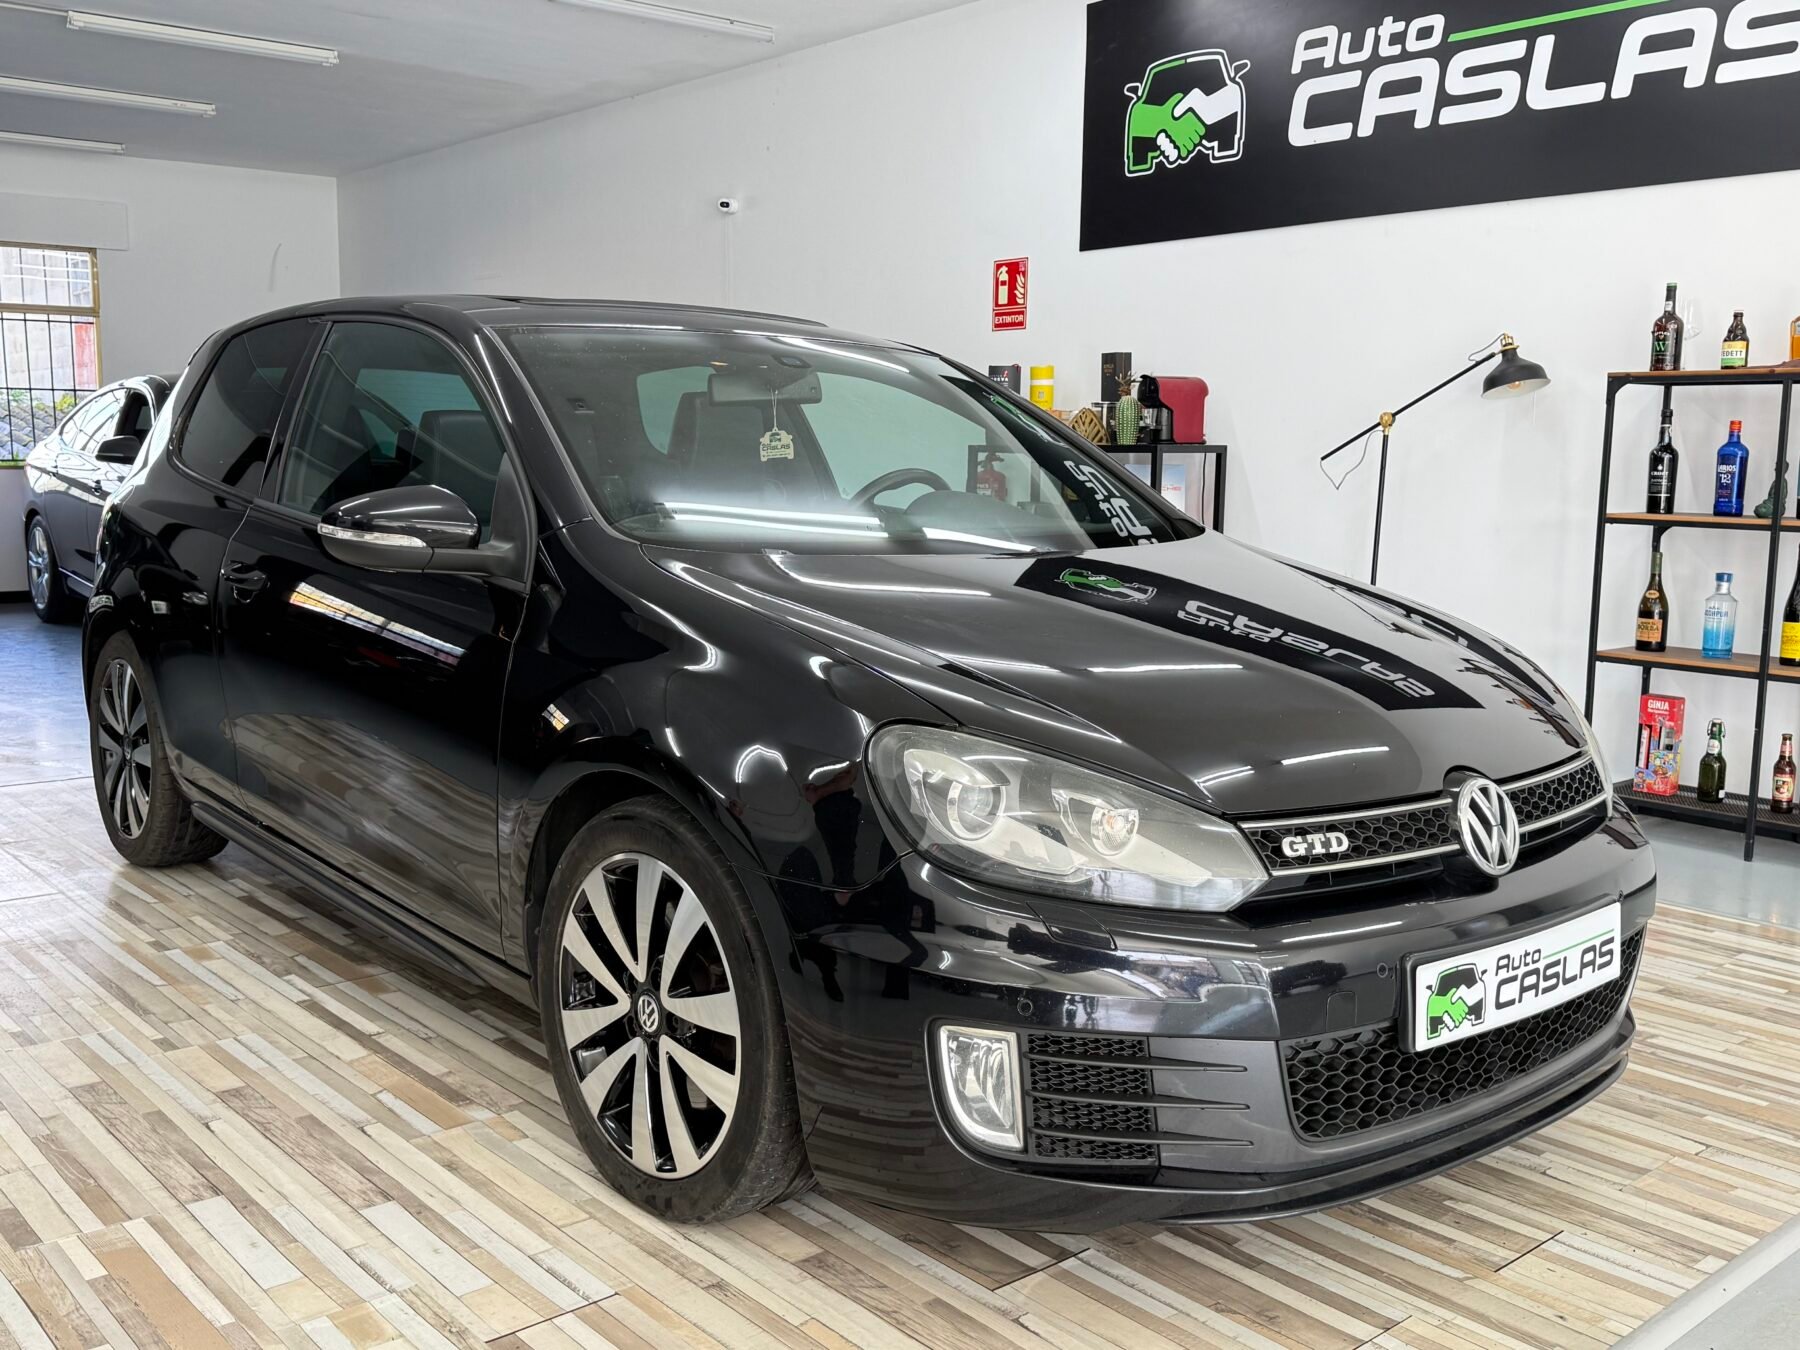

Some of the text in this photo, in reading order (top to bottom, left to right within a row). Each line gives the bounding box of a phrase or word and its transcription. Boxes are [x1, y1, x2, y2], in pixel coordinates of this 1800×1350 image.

[1291, 14, 1446, 75] Auto
[1288, 0, 1800, 147] CASLAS
[995, 314, 1024, 324] EXTINTOR
[762, 443, 791, 451] CASLAS
[1648, 699, 1669, 710] GINJA
[1281, 831, 1349, 858] GTD
[1494, 936, 1615, 1010] CASLAS
[1495, 948, 1542, 977] Auto
